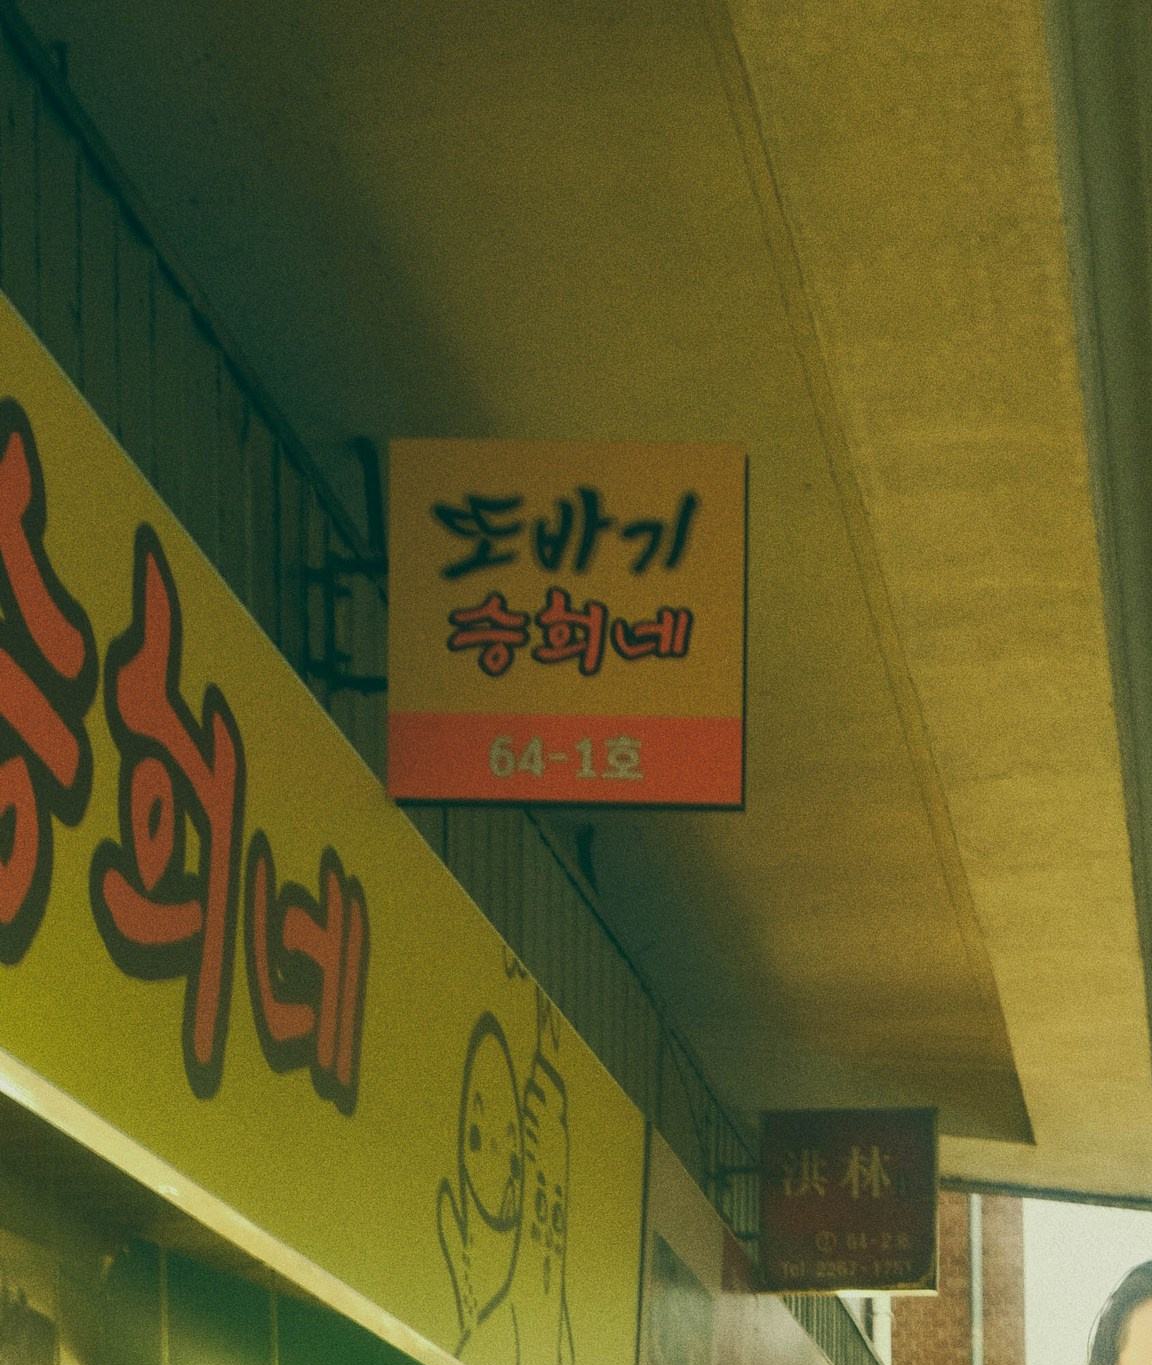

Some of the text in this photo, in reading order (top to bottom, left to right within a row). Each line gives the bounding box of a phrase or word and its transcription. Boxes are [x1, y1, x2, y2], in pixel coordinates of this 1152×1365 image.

[432, 486, 699, 579] 또바기
[447, 587, 694, 676] 승희네
[488, 734, 645, 780] 64-1호
